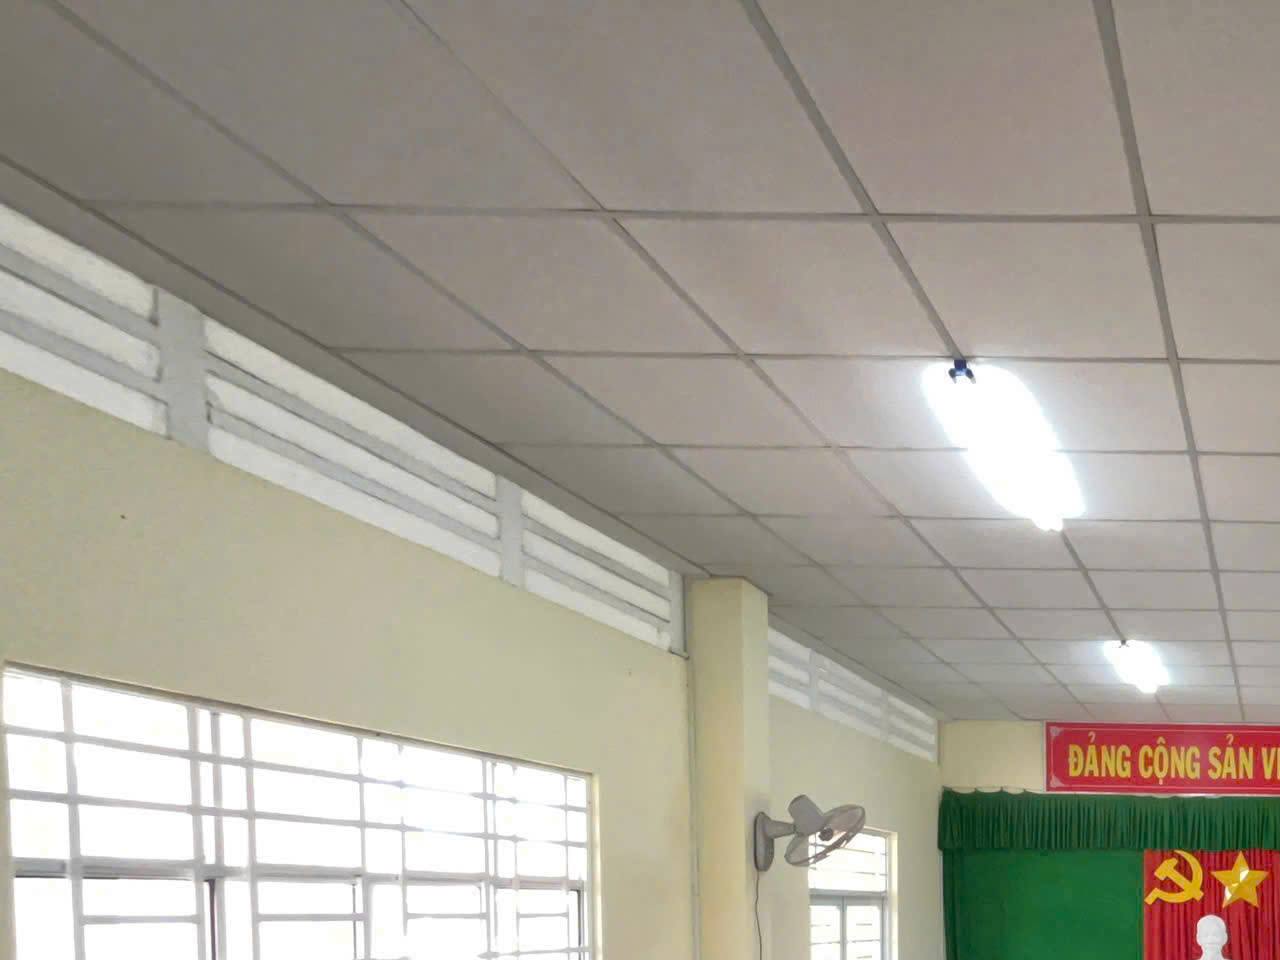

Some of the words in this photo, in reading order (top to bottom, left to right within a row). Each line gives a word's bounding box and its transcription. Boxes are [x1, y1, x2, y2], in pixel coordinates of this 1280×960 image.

[1068, 731, 1132, 778] ĐẢNG
[1138, 736, 1201, 785] CỘNG
[1207, 733, 1255, 780] SẢN
